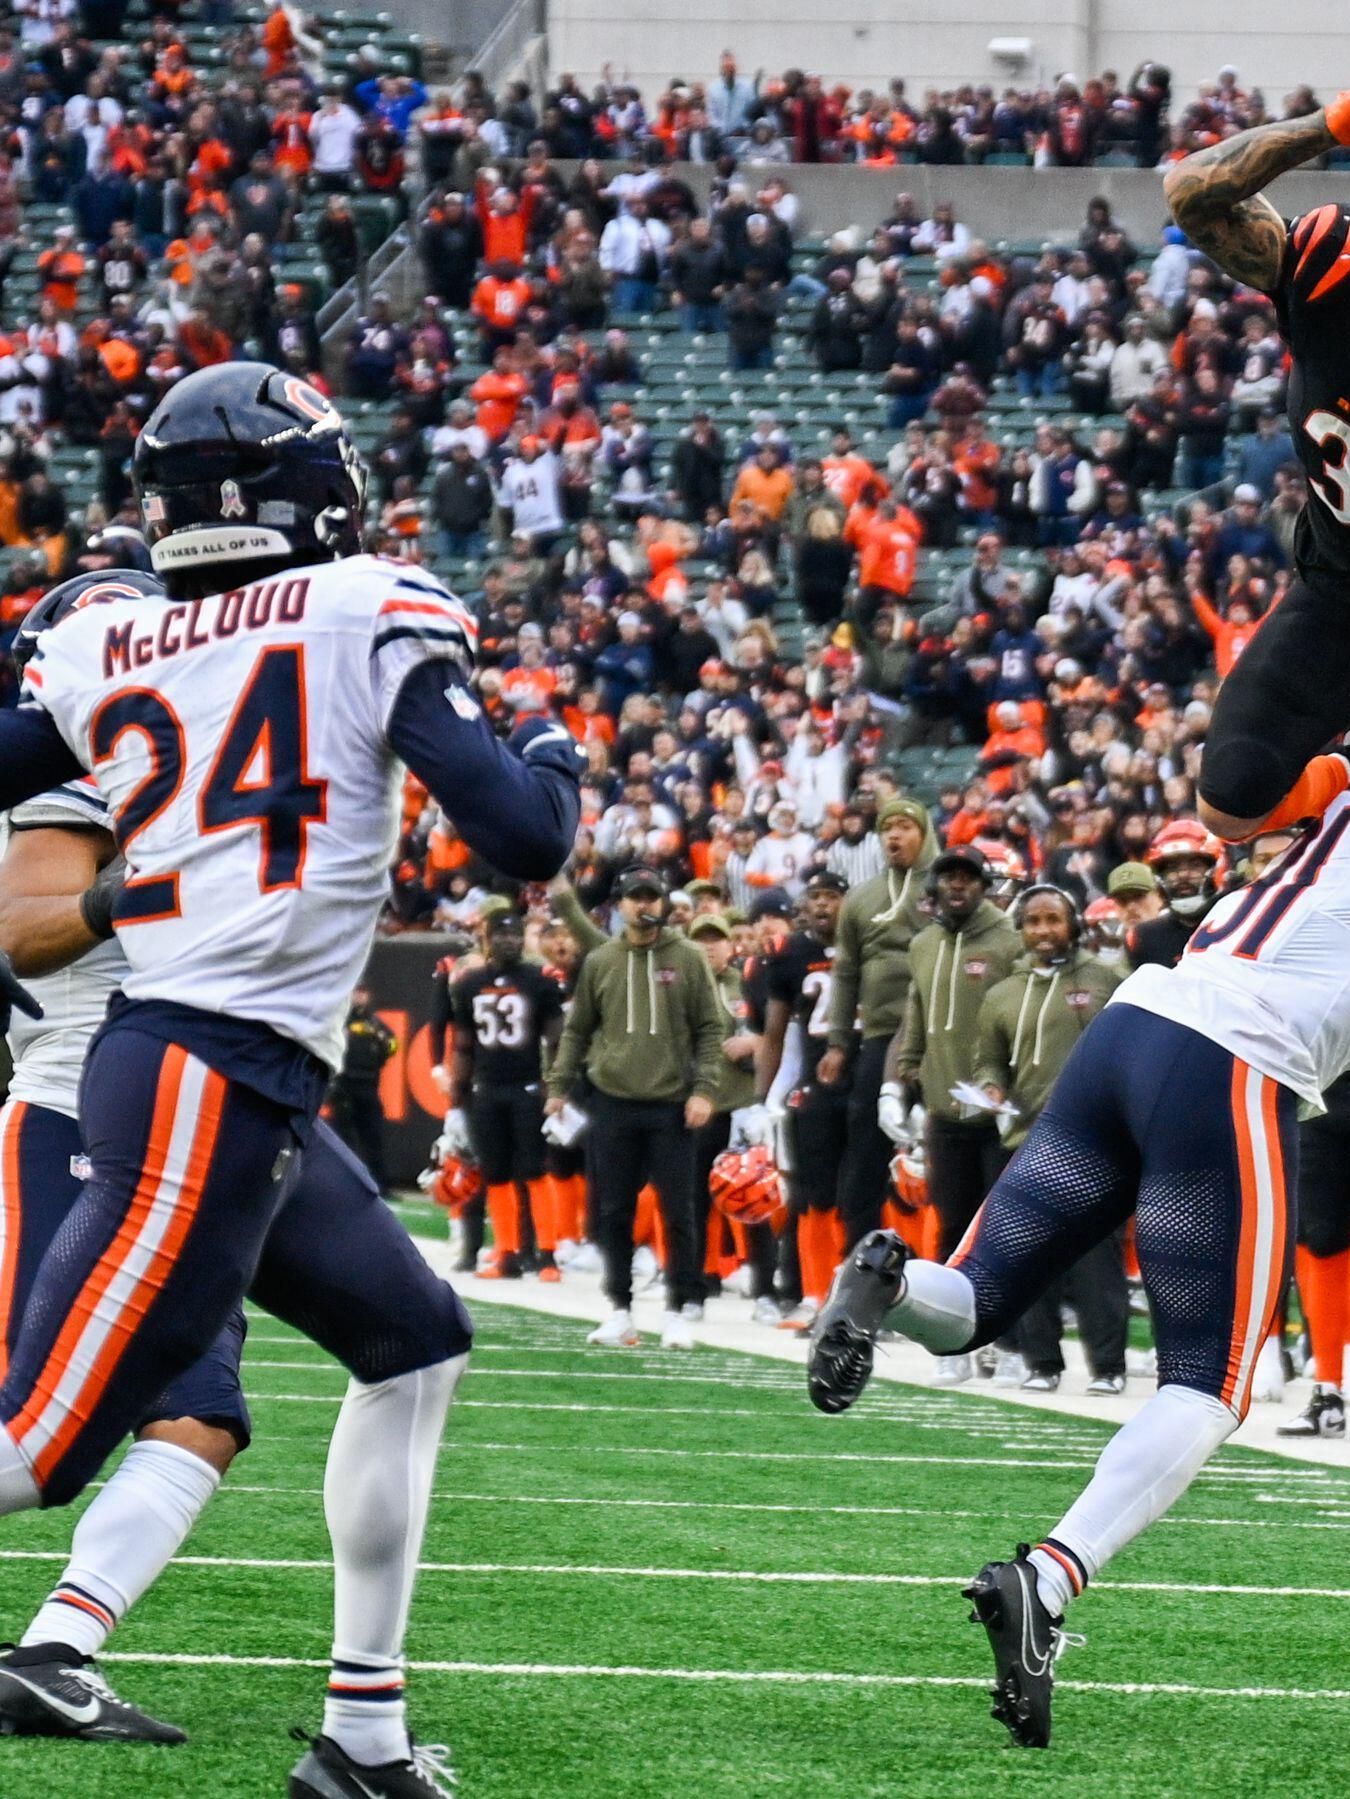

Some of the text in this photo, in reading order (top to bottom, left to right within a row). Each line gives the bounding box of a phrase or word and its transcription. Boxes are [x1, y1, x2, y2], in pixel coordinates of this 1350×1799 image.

[167, 546, 199, 559] TAKES
[202, 542, 226, 554] ALL
[229, 539, 248, 550] OF
[250, 537, 269, 547] US
[102, 578, 311, 680] McCLOUD
[89, 642, 329, 928] 24
[472, 993, 527, 1047] 53
